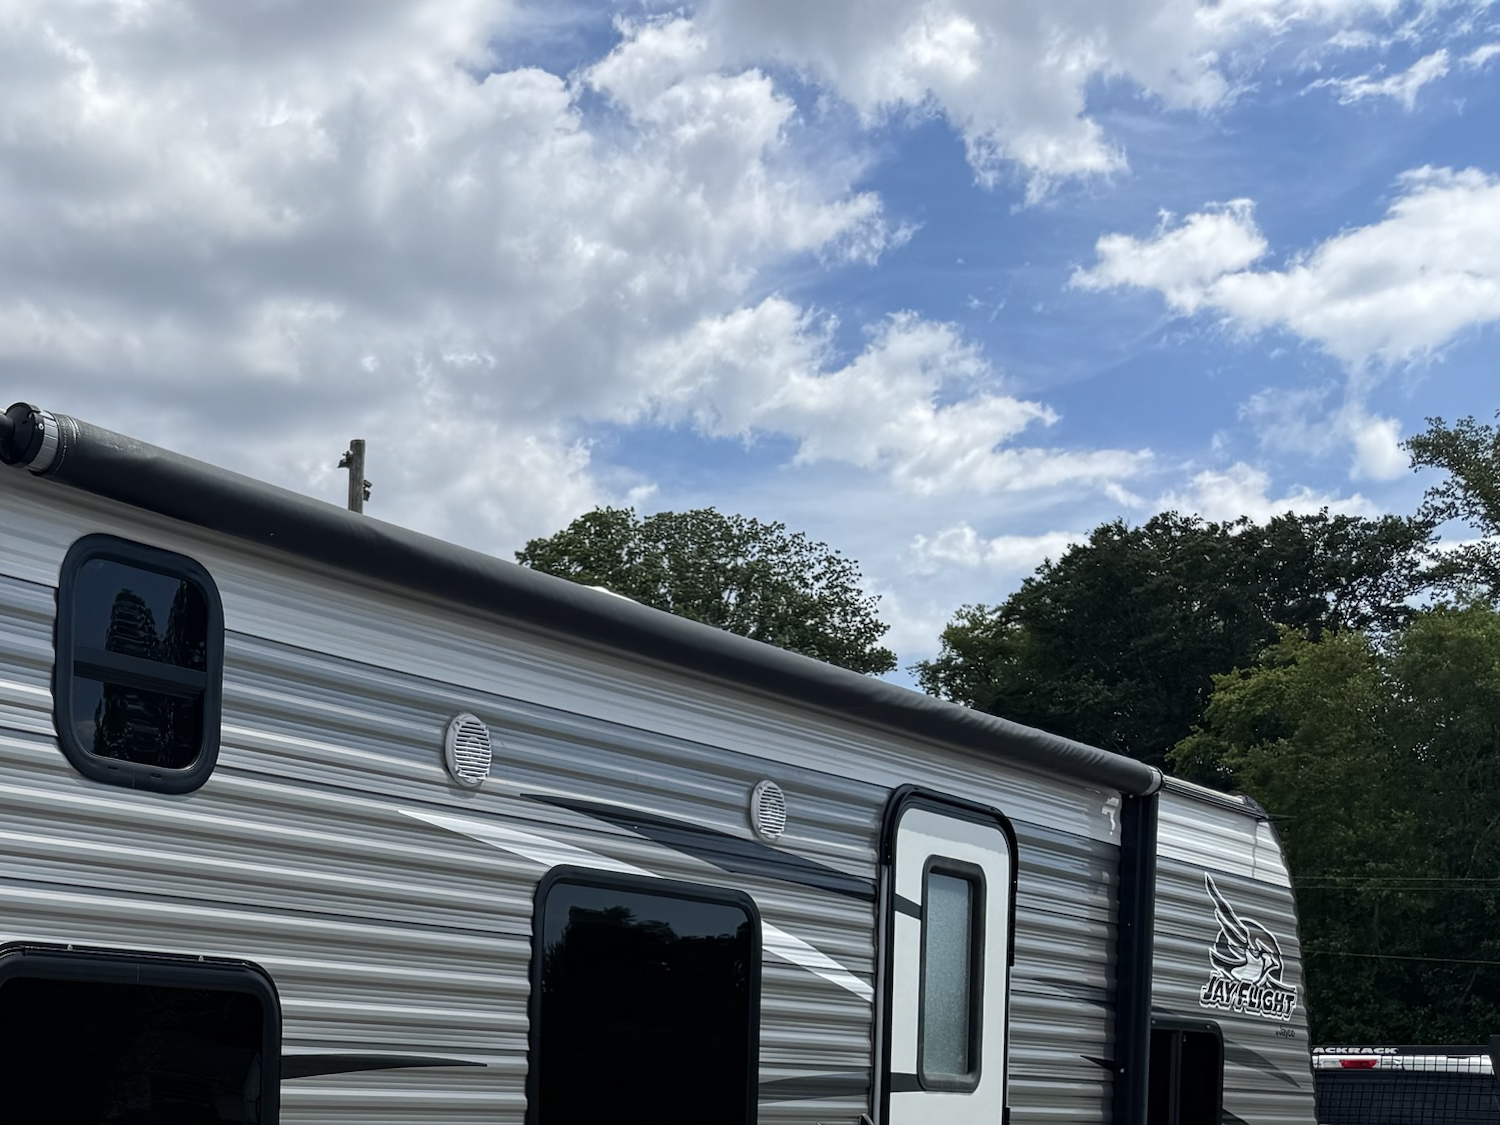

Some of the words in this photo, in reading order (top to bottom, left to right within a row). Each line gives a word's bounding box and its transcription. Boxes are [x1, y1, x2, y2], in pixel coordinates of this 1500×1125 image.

[1200, 973, 1239, 1010] JAY
[1235, 980, 1296, 1020] FLIGHT
[1312, 1047, 1399, 1055] ACKRACK
